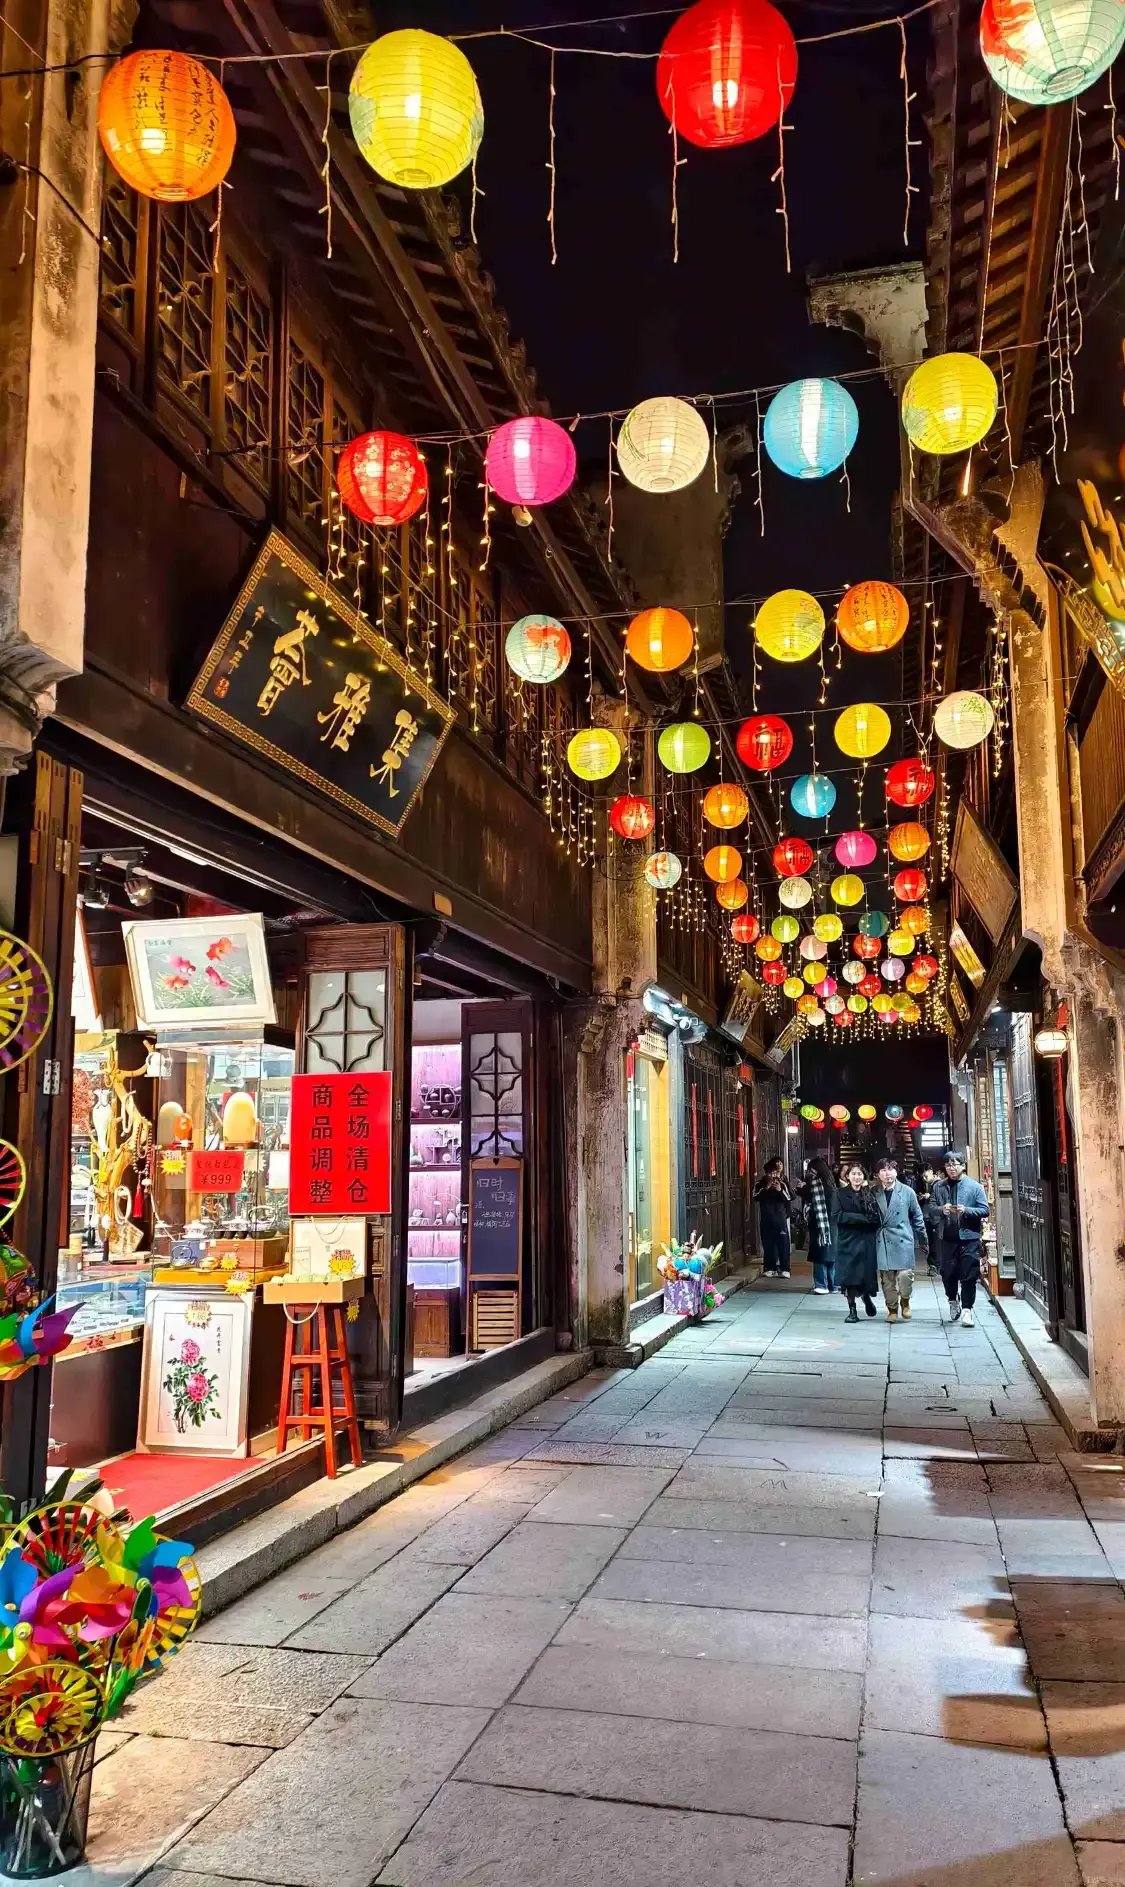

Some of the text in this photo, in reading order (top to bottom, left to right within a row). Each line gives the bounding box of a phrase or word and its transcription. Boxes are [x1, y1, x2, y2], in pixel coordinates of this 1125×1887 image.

[201, 1173, 232, 1185] ¥999
[310, 1084, 334, 1204] 商品调整
[346, 1083, 371, 1204] 全场清仓
